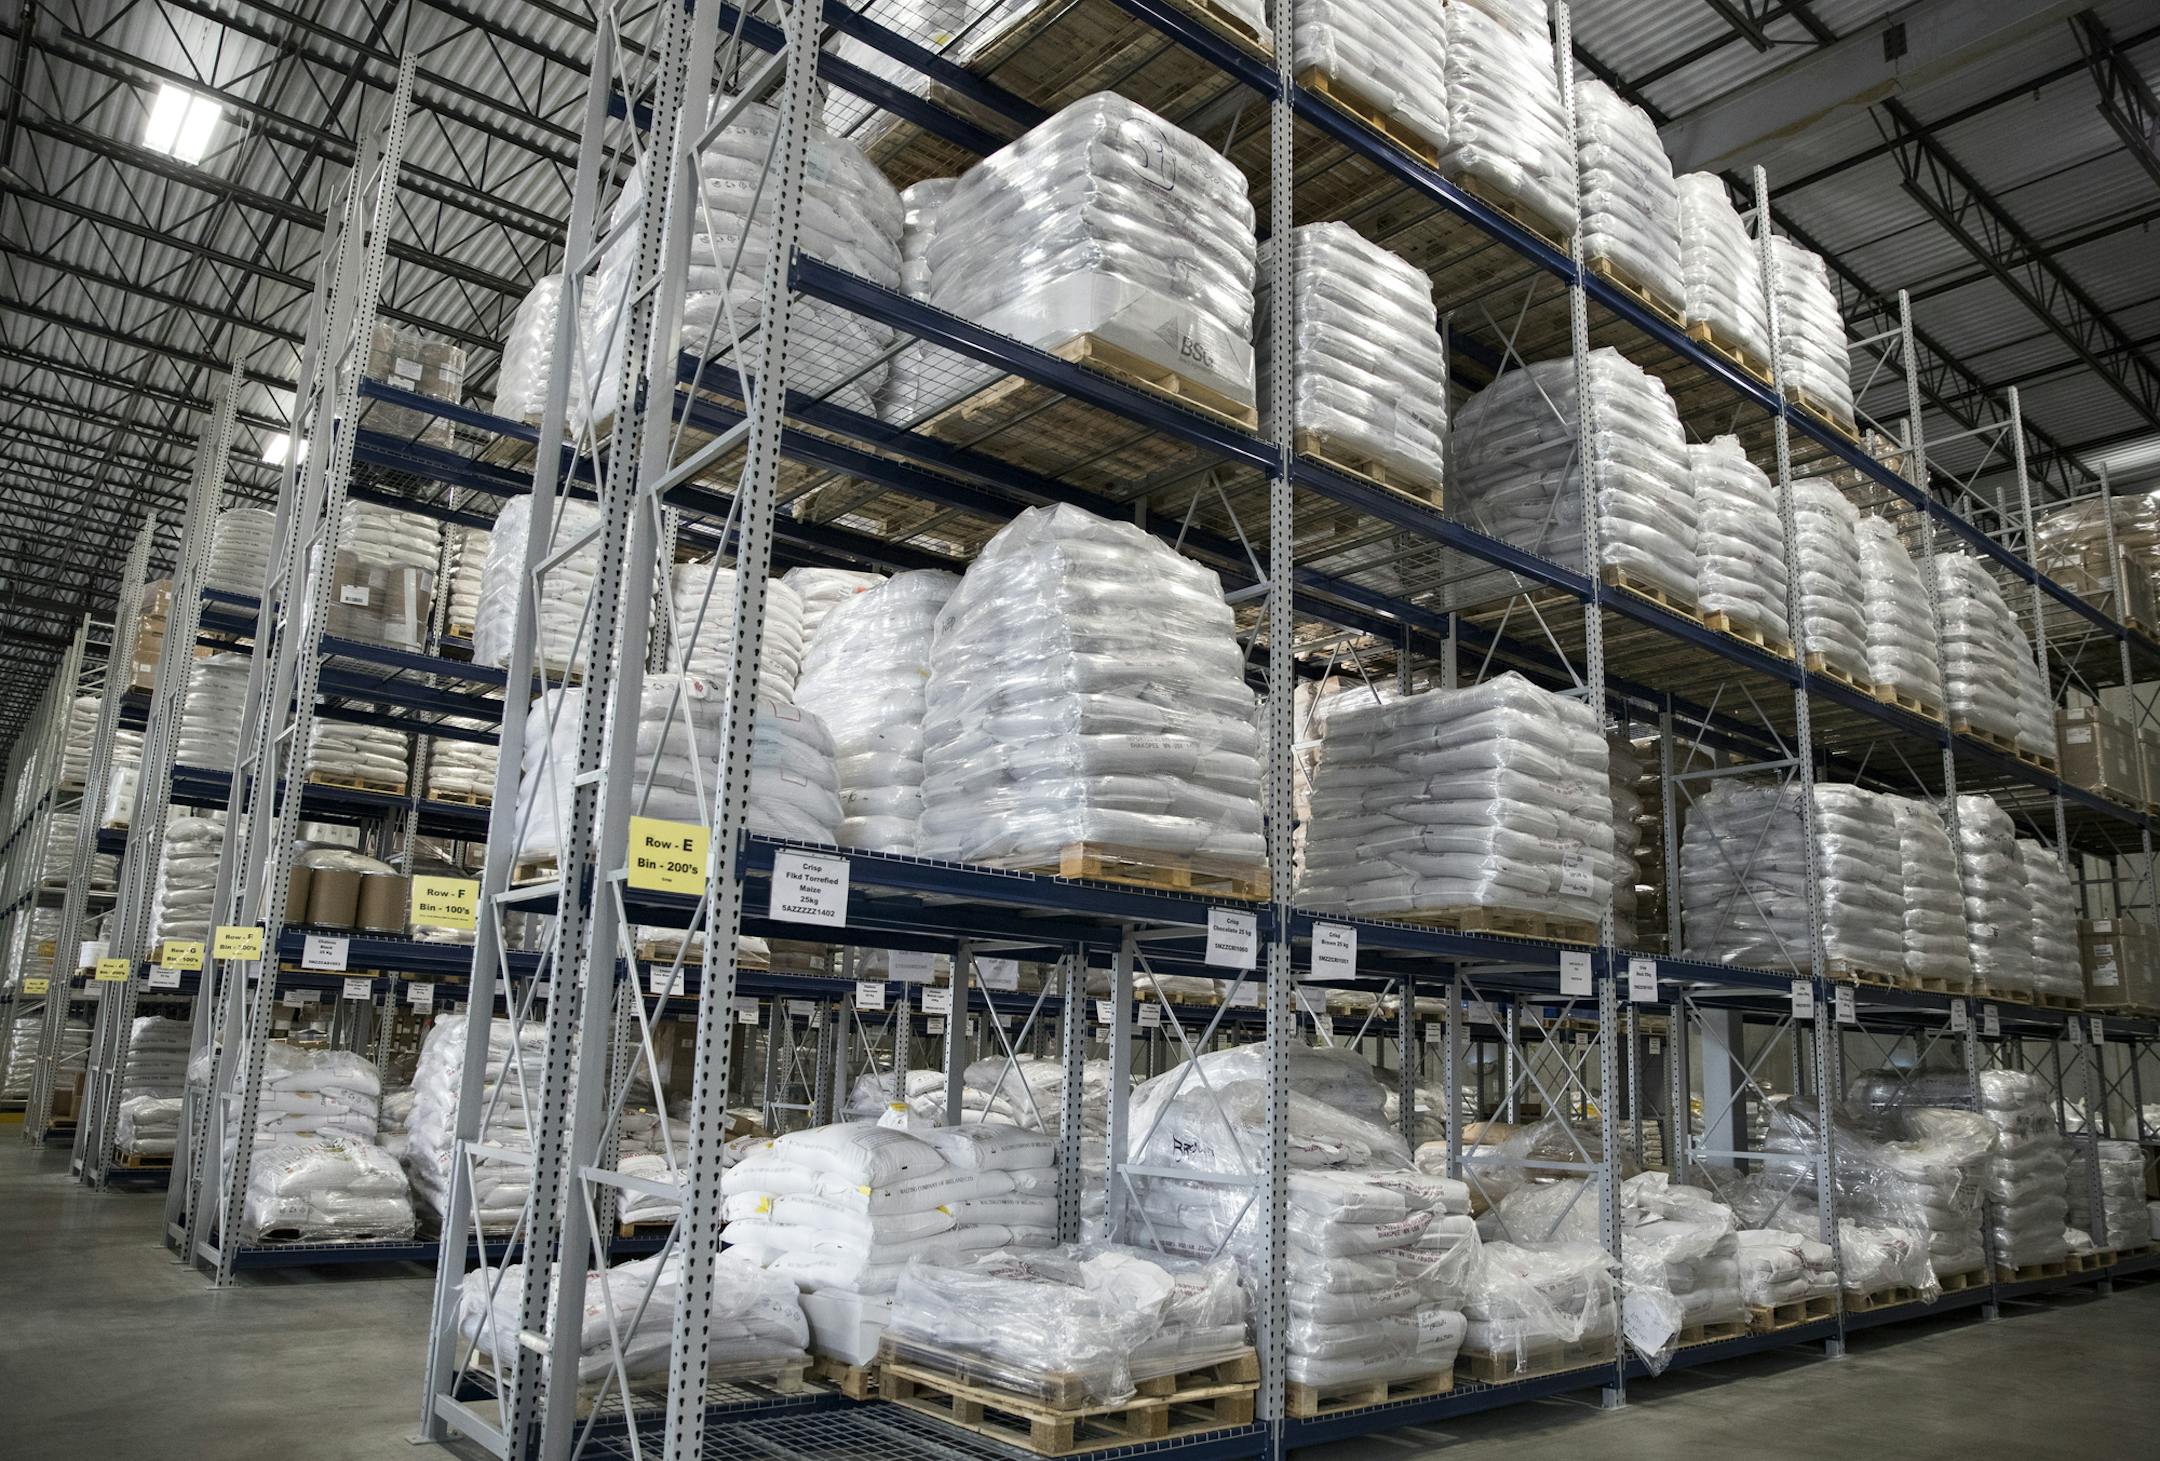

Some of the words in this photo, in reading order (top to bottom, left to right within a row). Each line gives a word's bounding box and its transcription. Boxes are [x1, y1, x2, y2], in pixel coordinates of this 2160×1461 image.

[645, 836, 672, 849] Row
[682, 838, 693, 852] E
[637, 857, 656, 870] Bin
[666, 861, 699, 875] 200's
[803, 863, 823, 872] Crisp
[786, 872, 803, 881] Flkd
[805, 875, 839, 885] Torrefied
[427, 888, 449, 897] Row
[458, 889, 466, 898] F
[799, 884, 822, 893] Maize
[800, 895, 819, 905] 25kg
[419, 903, 436, 911] Bin
[446, 905, 470, 915] 100's
